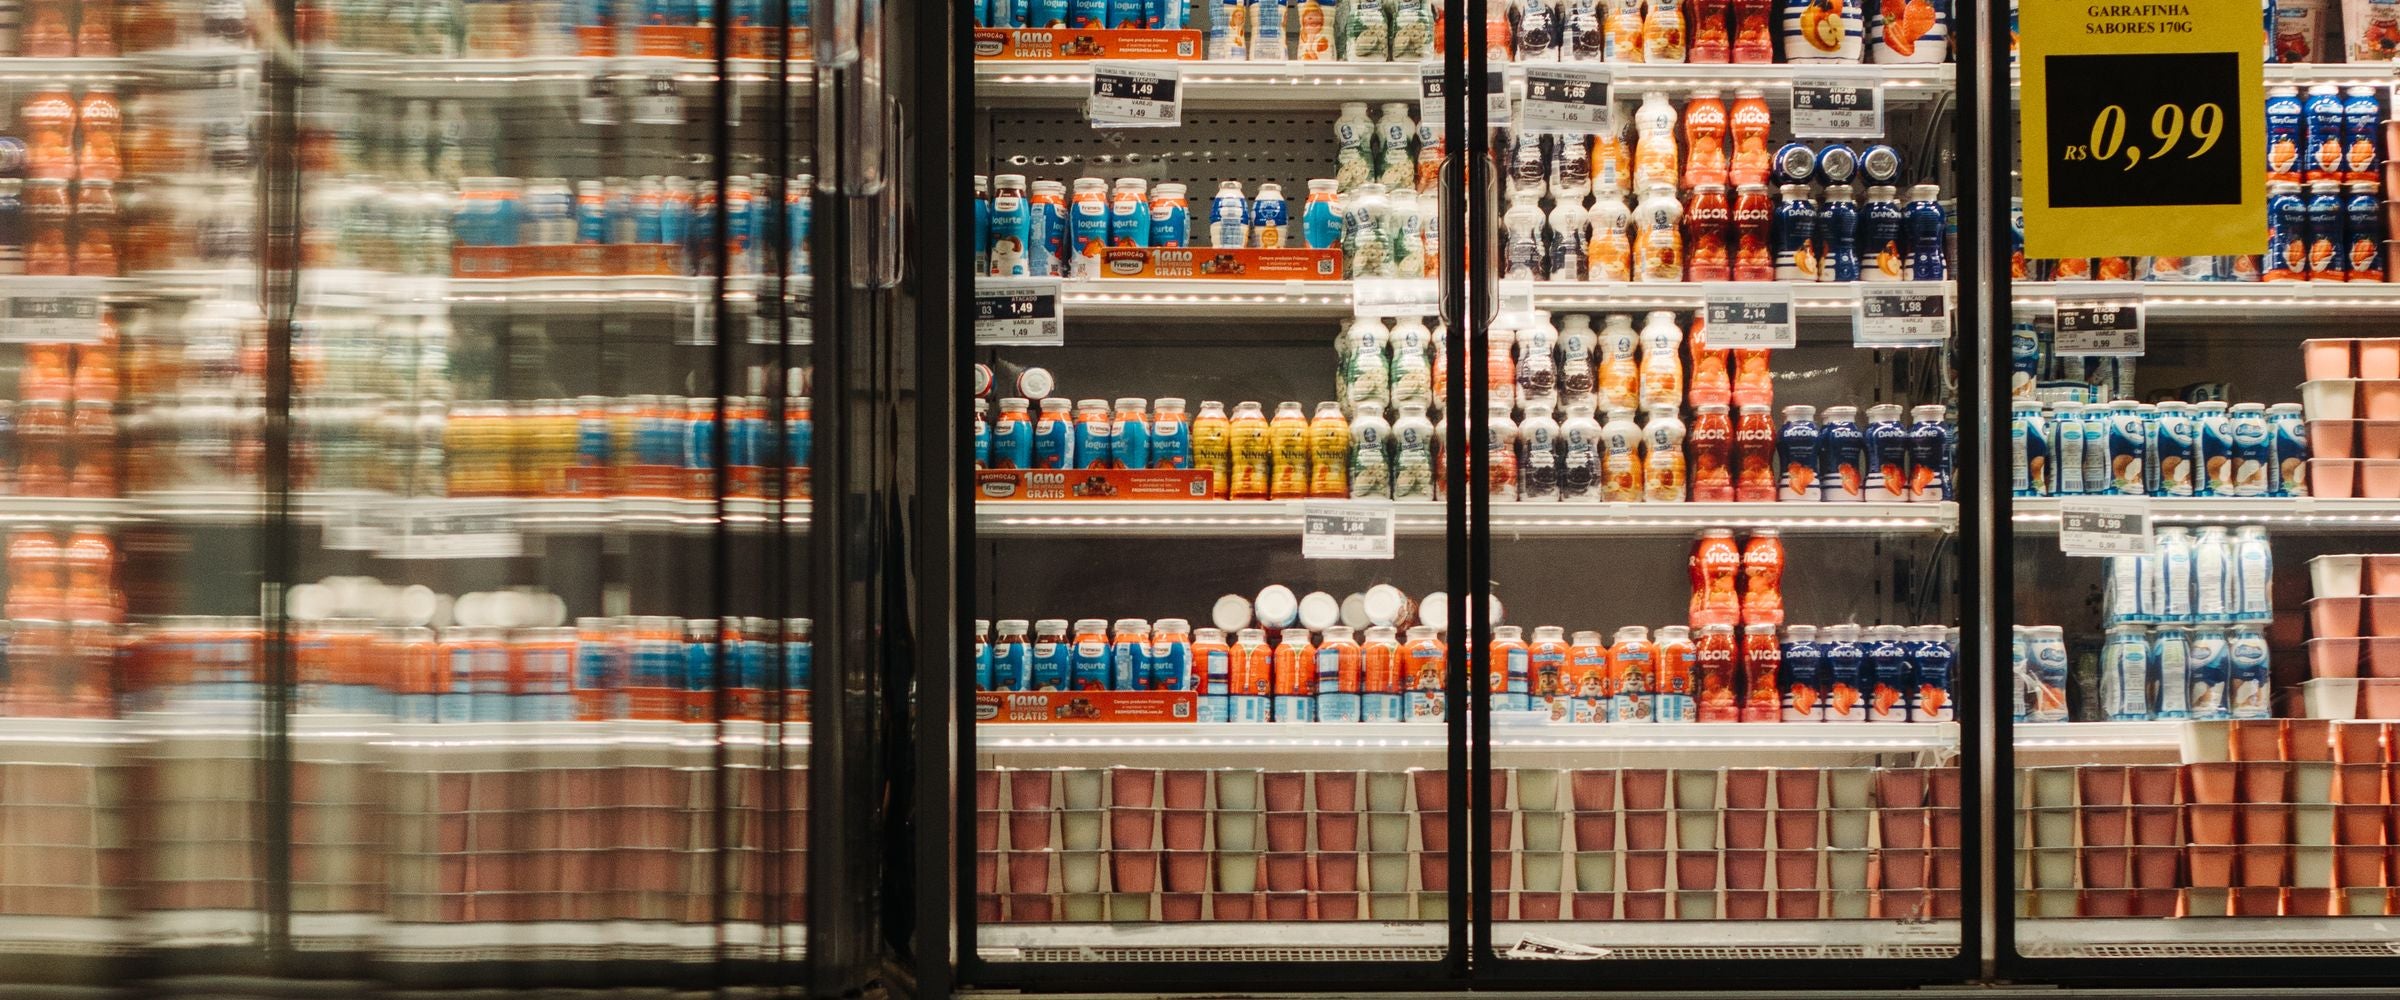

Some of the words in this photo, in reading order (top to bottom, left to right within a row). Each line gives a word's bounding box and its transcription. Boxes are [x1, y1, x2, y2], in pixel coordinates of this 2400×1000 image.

[2088, 5, 2189, 17] GARRAFINHA
[2086, 22, 2155, 34] SABORES
[2160, 21, 2193, 33] 170G
[1102, 83, 1112, 92] 03
[1131, 83, 1153, 95] 1,49
[1430, 83, 1441, 92] 03
[1534, 86, 1545, 95] 03
[1563, 86, 1586, 98] 1,65
[1800, 95, 1811, 104] 03
[1829, 94, 1857, 105] 10,59
[1130, 109, 1146, 117] 1,49
[1562, 112, 1578, 120] 1,65
[1688, 112, 1724, 124] VIGOR
[1734, 112, 1770, 124] VIGOR
[2064, 145, 2087, 161] R$
[2090, 103, 2224, 171] 0,99
[1691, 208, 1728, 220] VIGOR
[1078, 220, 1106, 229] Iogurte
[1112, 220, 1138, 229] ogurte
[981, 306, 992, 314] 03
[1010, 303, 1033, 314] 1,49
[1870, 304, 1881, 312] 03
[1899, 302, 1922, 312] 1,98
[1743, 308, 1766, 319] 2,14
[2065, 317, 2075, 325] 03
[2092, 314, 2115, 325] 0,99
[1012, 328, 1028, 336] 1,49
[1736, 429, 1771, 441] VIGOR
[1342, 522, 1364, 532] 1,84
[2098, 519, 2121, 529] 0,99
